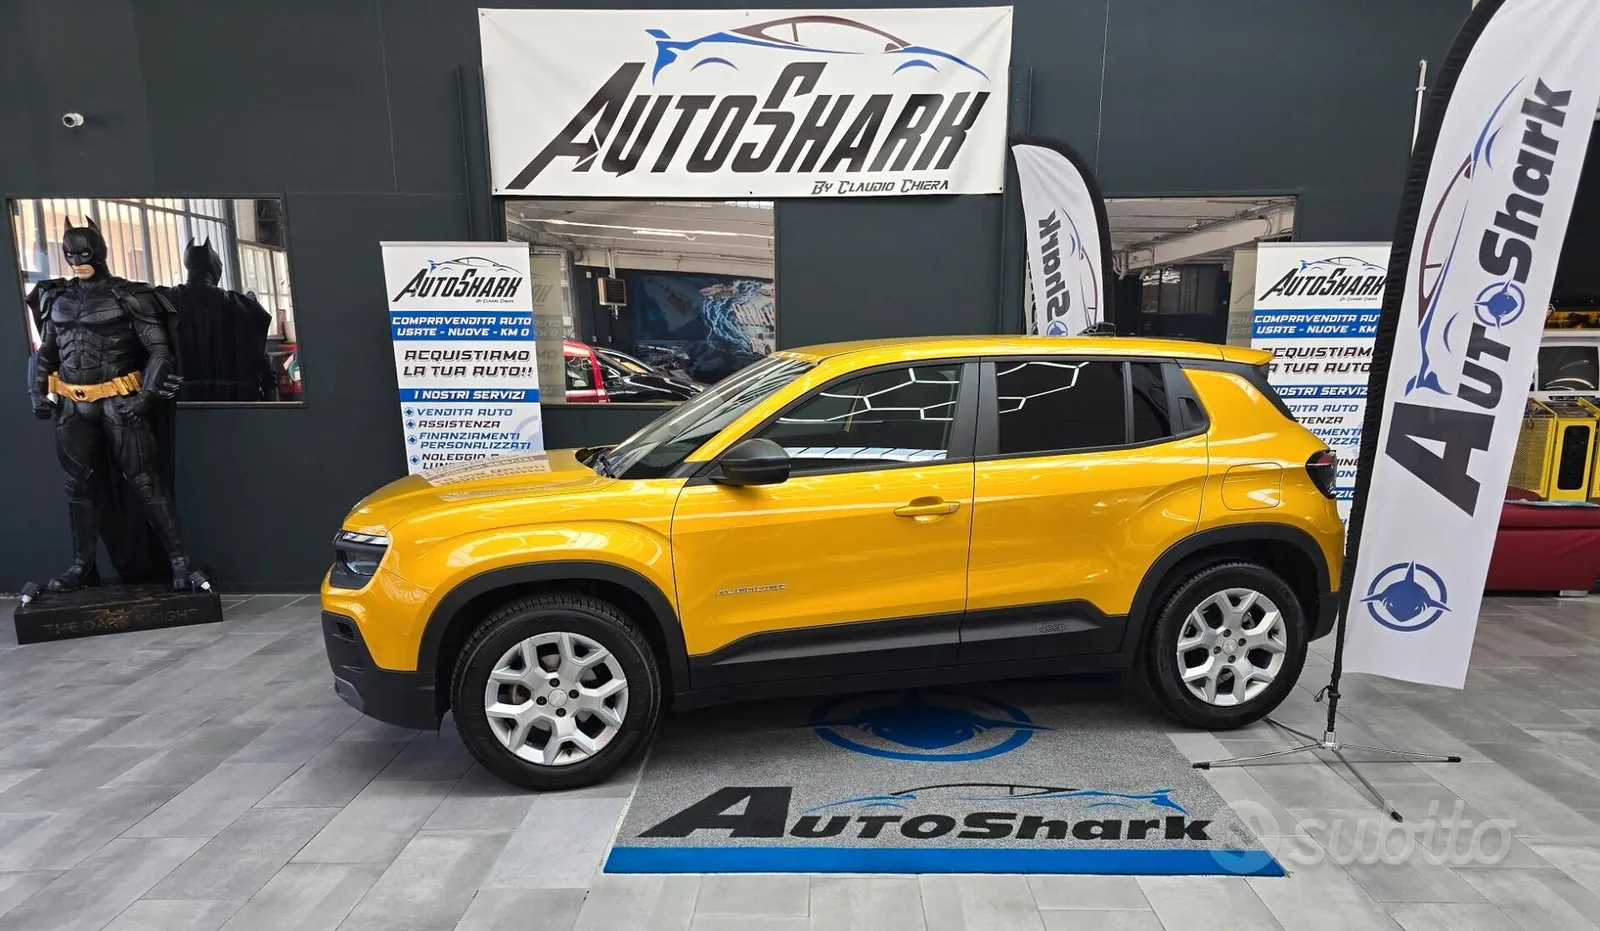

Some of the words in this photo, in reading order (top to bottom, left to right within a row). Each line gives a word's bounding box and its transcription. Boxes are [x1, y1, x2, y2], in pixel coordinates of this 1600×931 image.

[504, 61, 991, 190] AUTOSHARK
[811, 180, 833, 195] By
[838, 180, 895, 194] Claudio
[900, 179, 949, 193] Chiera
[392, 268, 523, 302] AUTOSHARK
[1258, 267, 1387, 301] AUTOSHARK
[392, 317, 496, 325] COMPRAVENDITA
[499, 317, 532, 325] AUTO
[1254, 315, 1358, 323] COMPRAVENDITA
[397, 328, 437, 336] USATE
[447, 328, 490, 336] NUOVE
[500, 328, 518, 336] KM
[1256, 326, 1297, 334] USATE
[1306, 325, 1349, 333] NUOVE
[1358, 325, 1377, 333] KM
[404, 350, 531, 361] ACQUISTIAMO
[1262, 347, 1373, 358] CQUISTIAM
[403, 366, 426, 377] LA
[431, 366, 467, 377] TUA
[472, 366, 532, 378] AUTO!!
[1284, 362, 1318, 373] TUA
[1323, 362, 1371, 372] AUTO
[414, 391, 419, 399] I
[422, 391, 469, 400] NOSTRI
[473, 391, 526, 400] SERVIZI
[1320, 386, 1368, 395] SERVIZ
[417, 408, 473, 416] VENDITA
[477, 408, 513, 416] AUTO
[1288, 404, 1318, 413] DITA
[1322, 404, 1359, 413] AUTO
[418, 420, 501, 428] ASSISTENZA
[420, 441, 531, 449] PERSONALIZZATI
[44, 620, 79, 635] THE
[1039, 620, 1067, 634] Jeep
